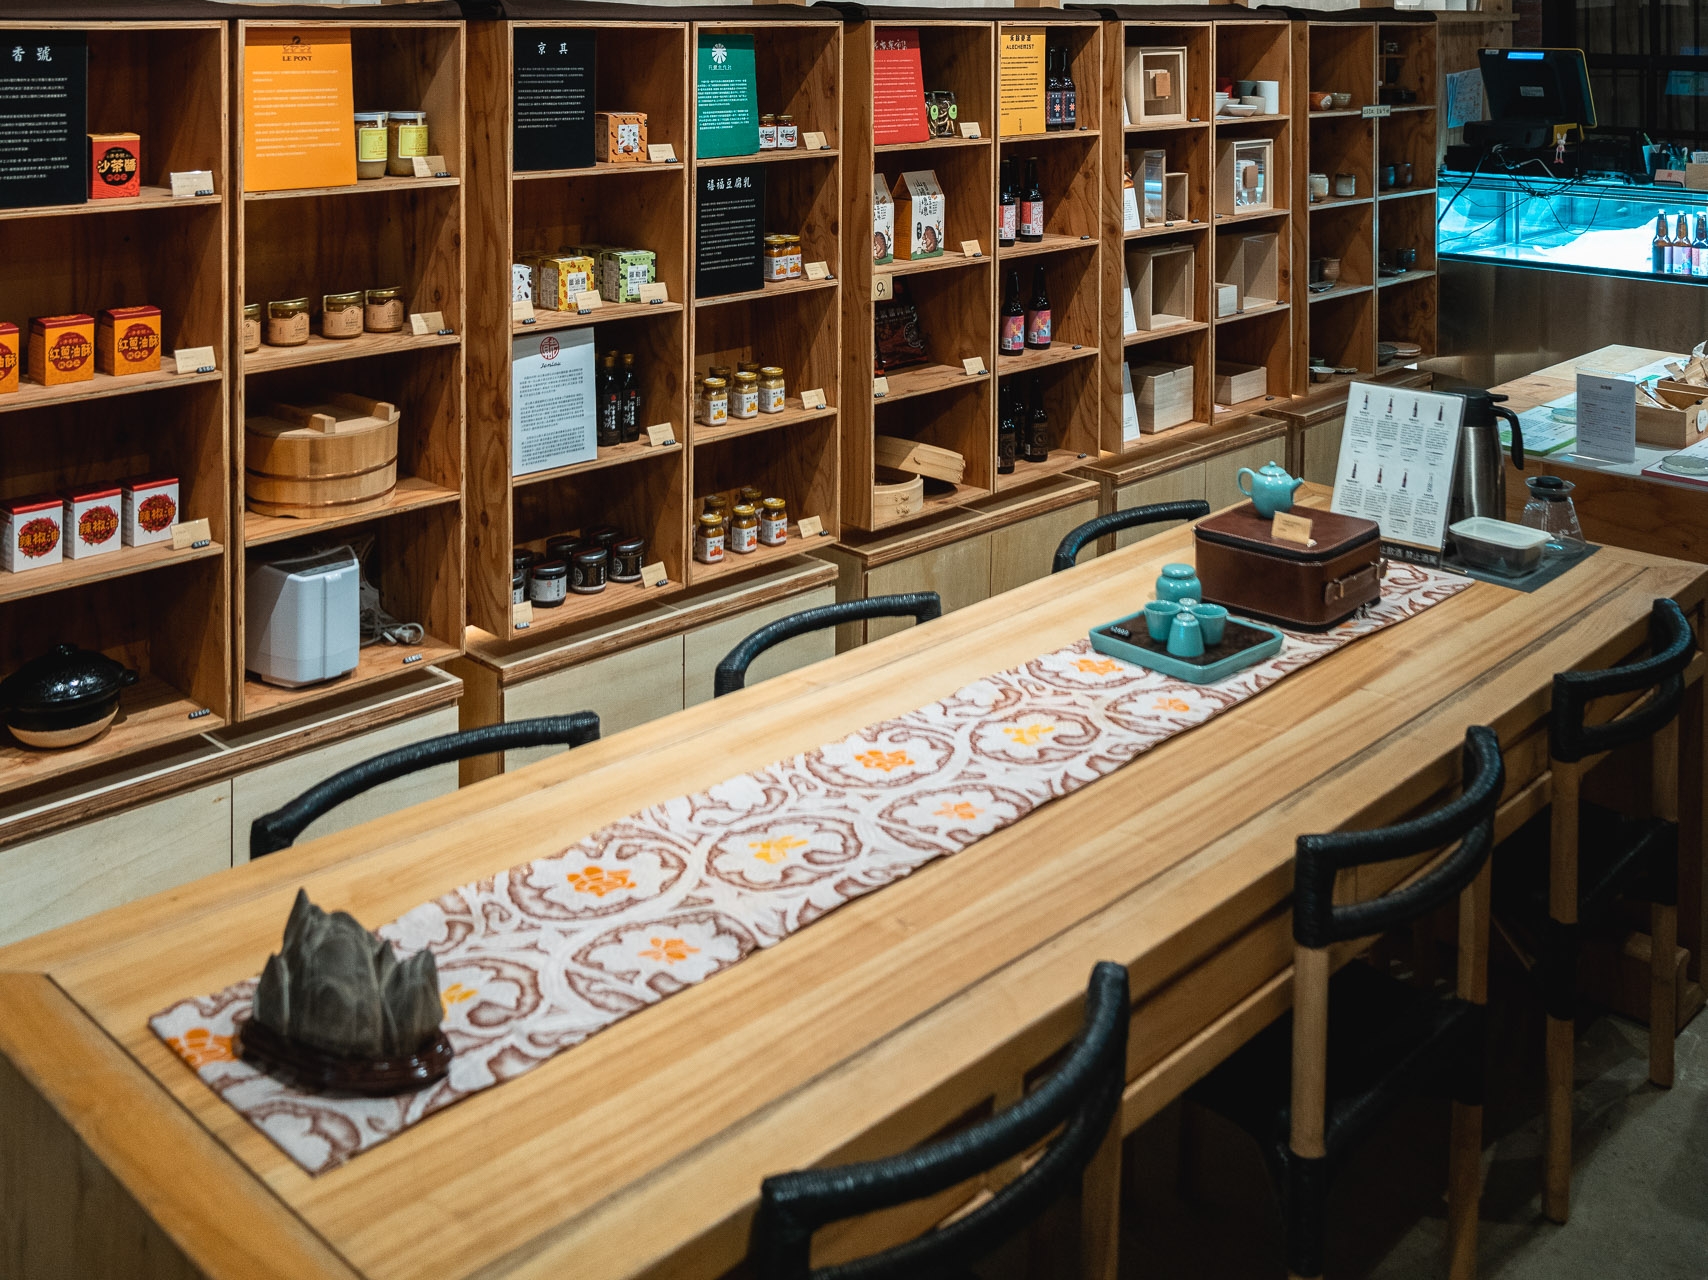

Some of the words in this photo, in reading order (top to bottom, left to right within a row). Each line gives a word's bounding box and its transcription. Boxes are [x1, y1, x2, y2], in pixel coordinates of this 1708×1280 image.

[97, 158, 137, 173] 沙茶醬
[49, 343, 93, 362] 紅蔥油酥
[118, 334, 160, 352] 紅蔥油酥
[138, 503, 177, 523] 辣椒油
[78, 514, 119, 535] 辣椒油
[18, 527, 60, 548] 辣椒油
